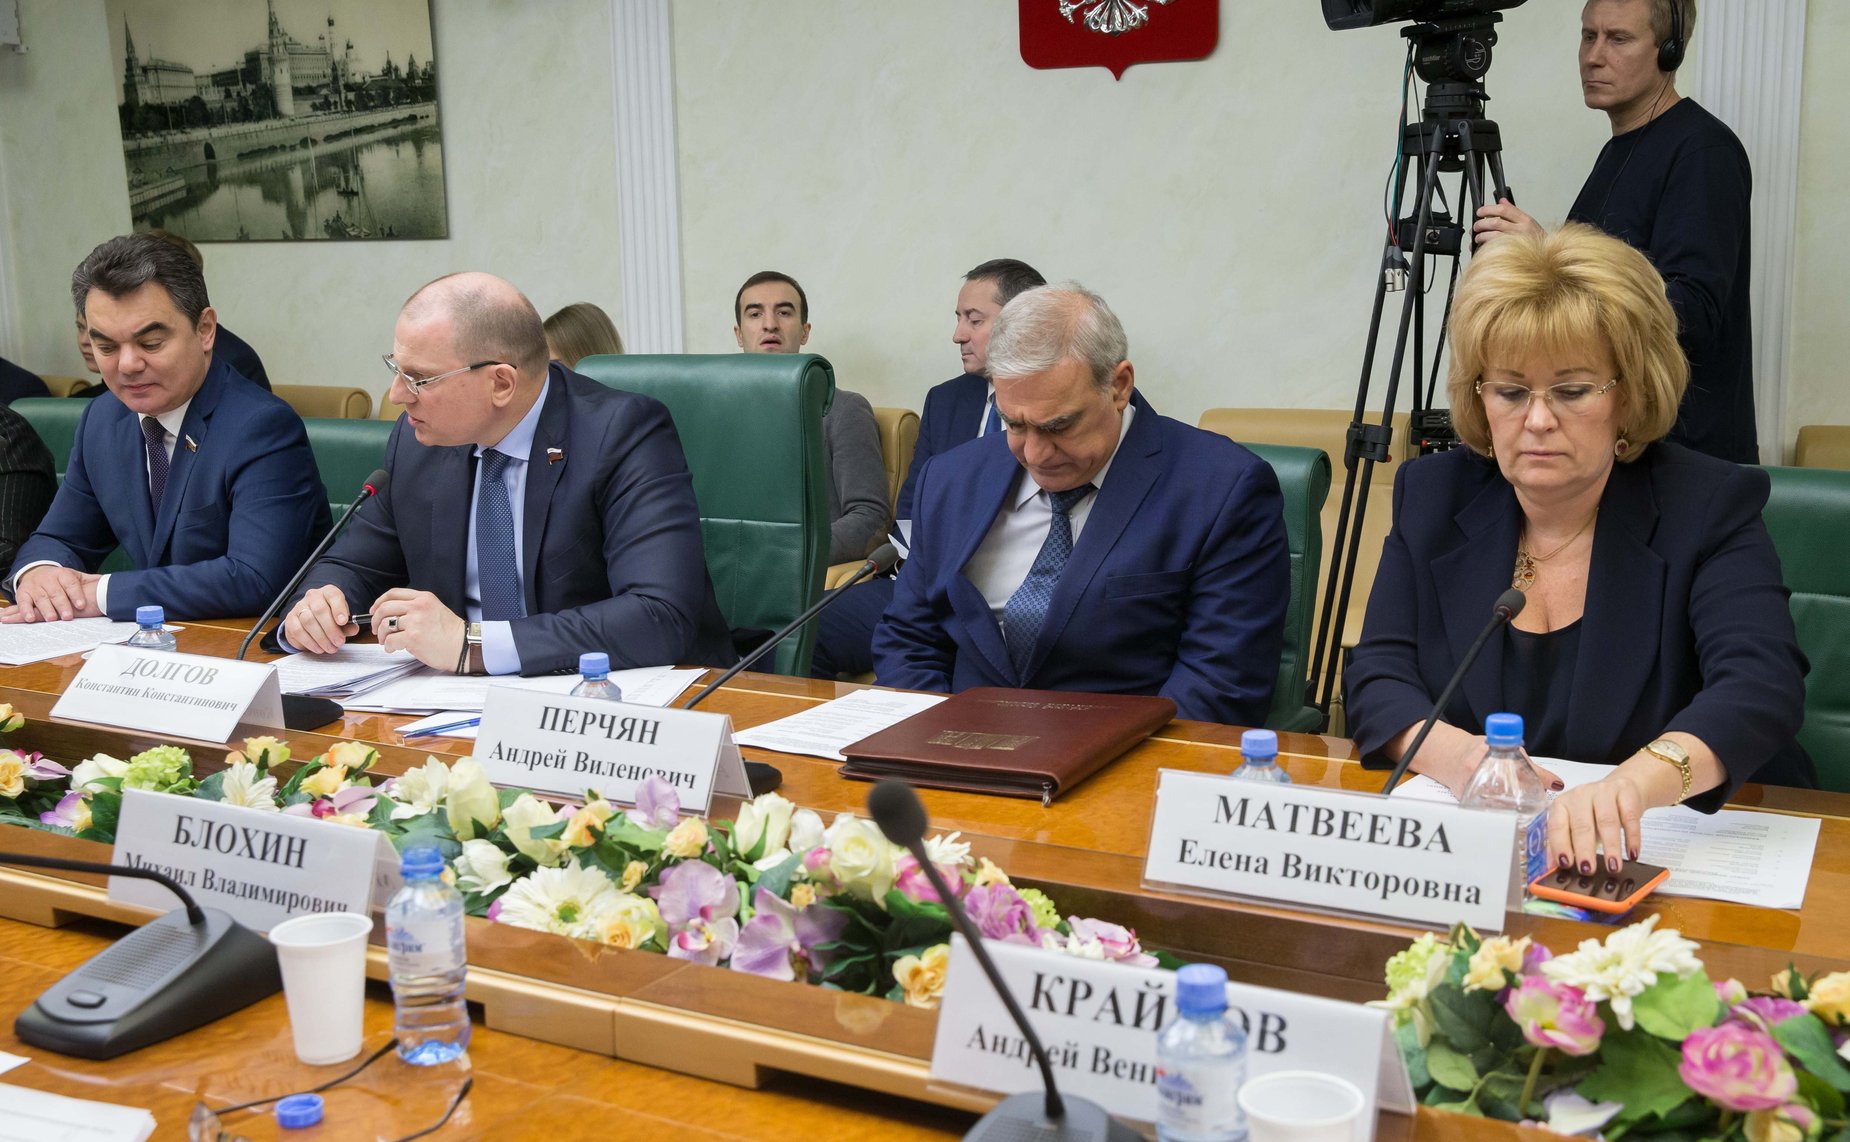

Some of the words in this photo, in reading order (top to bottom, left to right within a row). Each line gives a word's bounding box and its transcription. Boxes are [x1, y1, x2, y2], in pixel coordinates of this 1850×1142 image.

[75, 677, 143, 698] Константин
[140, 686, 239, 712] Константинович
[120, 657, 220, 686] ДОЛГОВ
[537, 705, 662, 746] ПЕРЧЯН
[489, 740, 567, 771] Андрей
[172, 814, 308, 869] БЛОХИН
[1213, 794, 1454, 854] МАТВЕЕВА
[201, 867, 348, 915] Владимирович
[1176, 838, 1269, 876] Елена
[1281, 853, 1482, 906] Викторовна
[1029, 971, 1288, 1054] КРАЙВ
